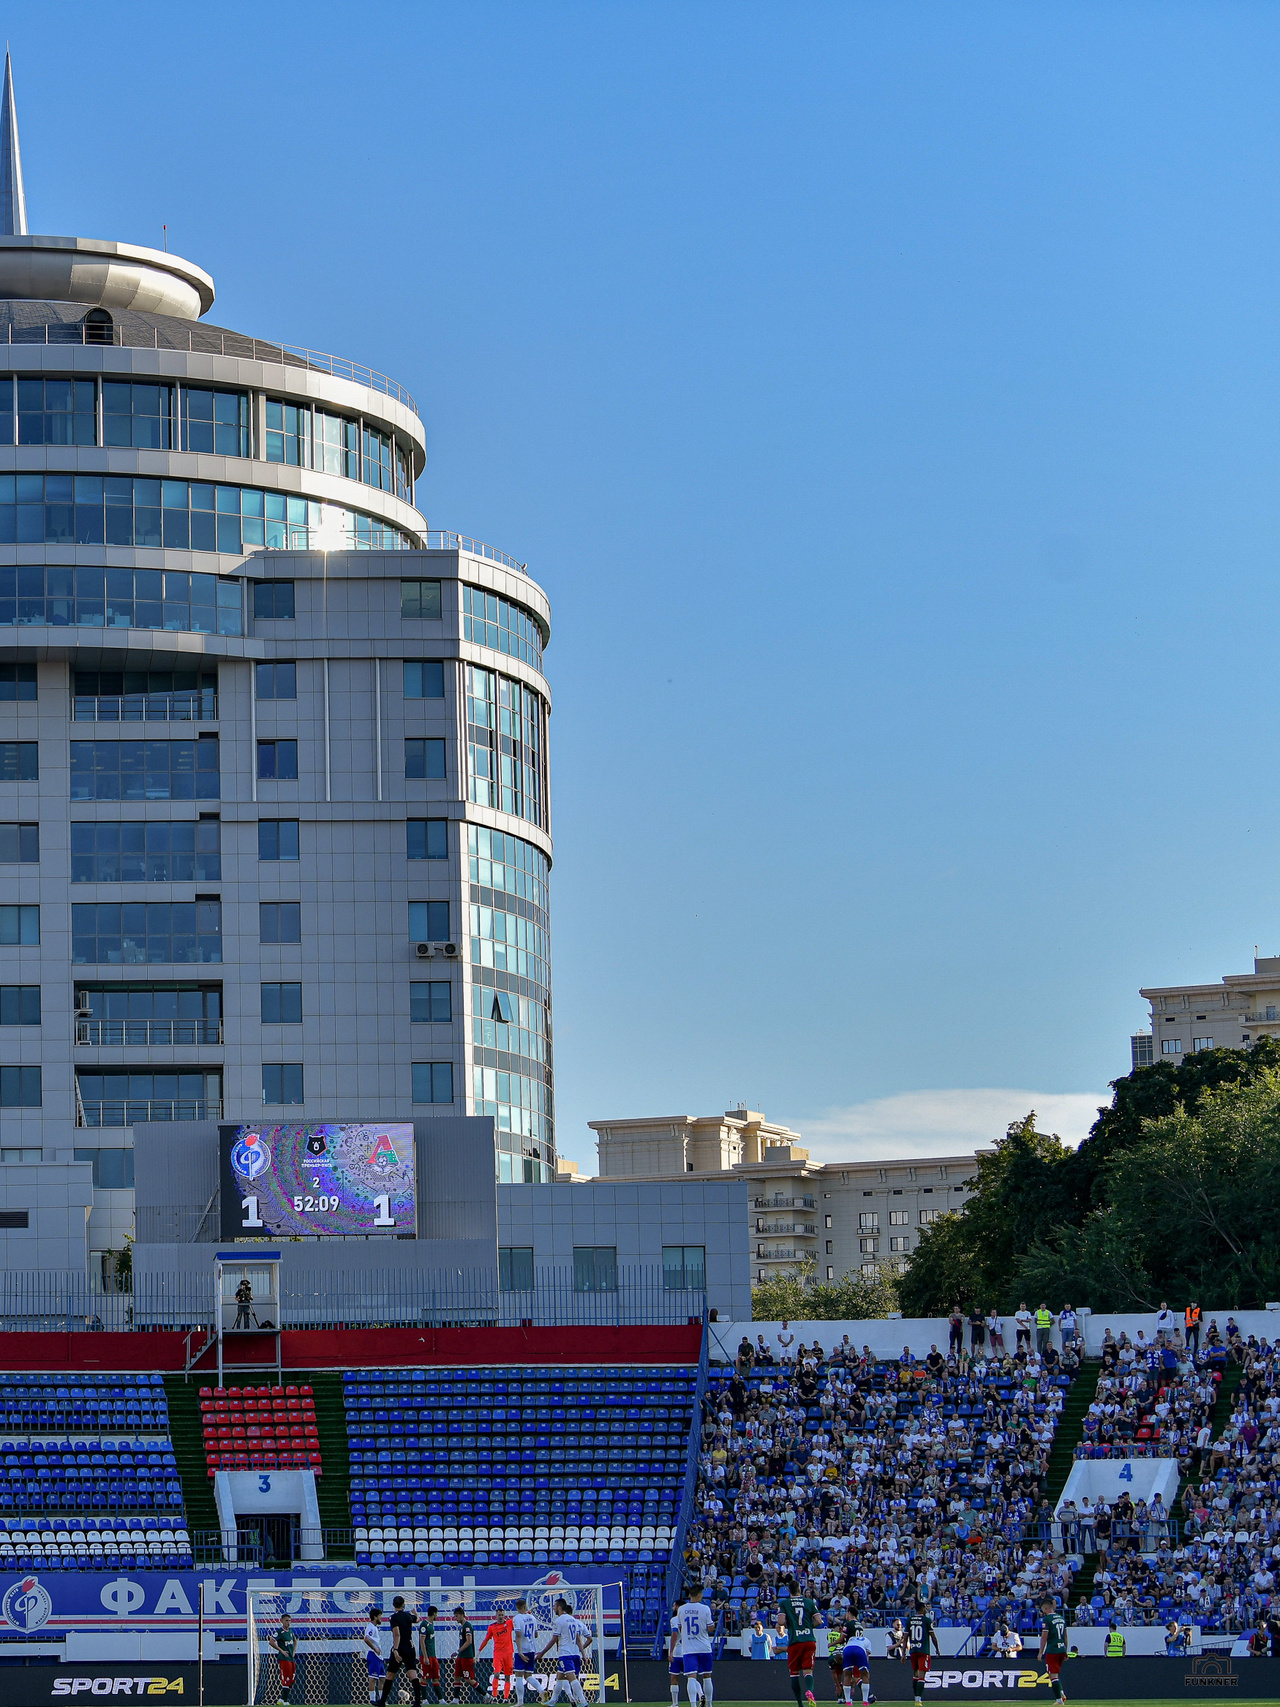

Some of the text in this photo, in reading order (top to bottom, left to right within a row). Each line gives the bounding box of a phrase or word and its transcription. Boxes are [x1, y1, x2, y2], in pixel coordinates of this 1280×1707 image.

[312, 1176, 320, 1188] 2
[241, 1196, 263, 1227] 1
[293, 1195, 340, 1212] 52:09
[373, 1195, 395, 1226] 1
[1118, 1463, 1133, 1482] 4
[258, 1475, 271, 1493] 3
[794, 1607, 804, 1626] 7
[684, 1616, 700, 1636] 15
[910, 1625, 923, 1641] 10
[1055, 1623, 1064, 1640] 17
[51, 1677, 184, 1695] SPORT24
[924, 1670, 1052, 1688] SPORT24
